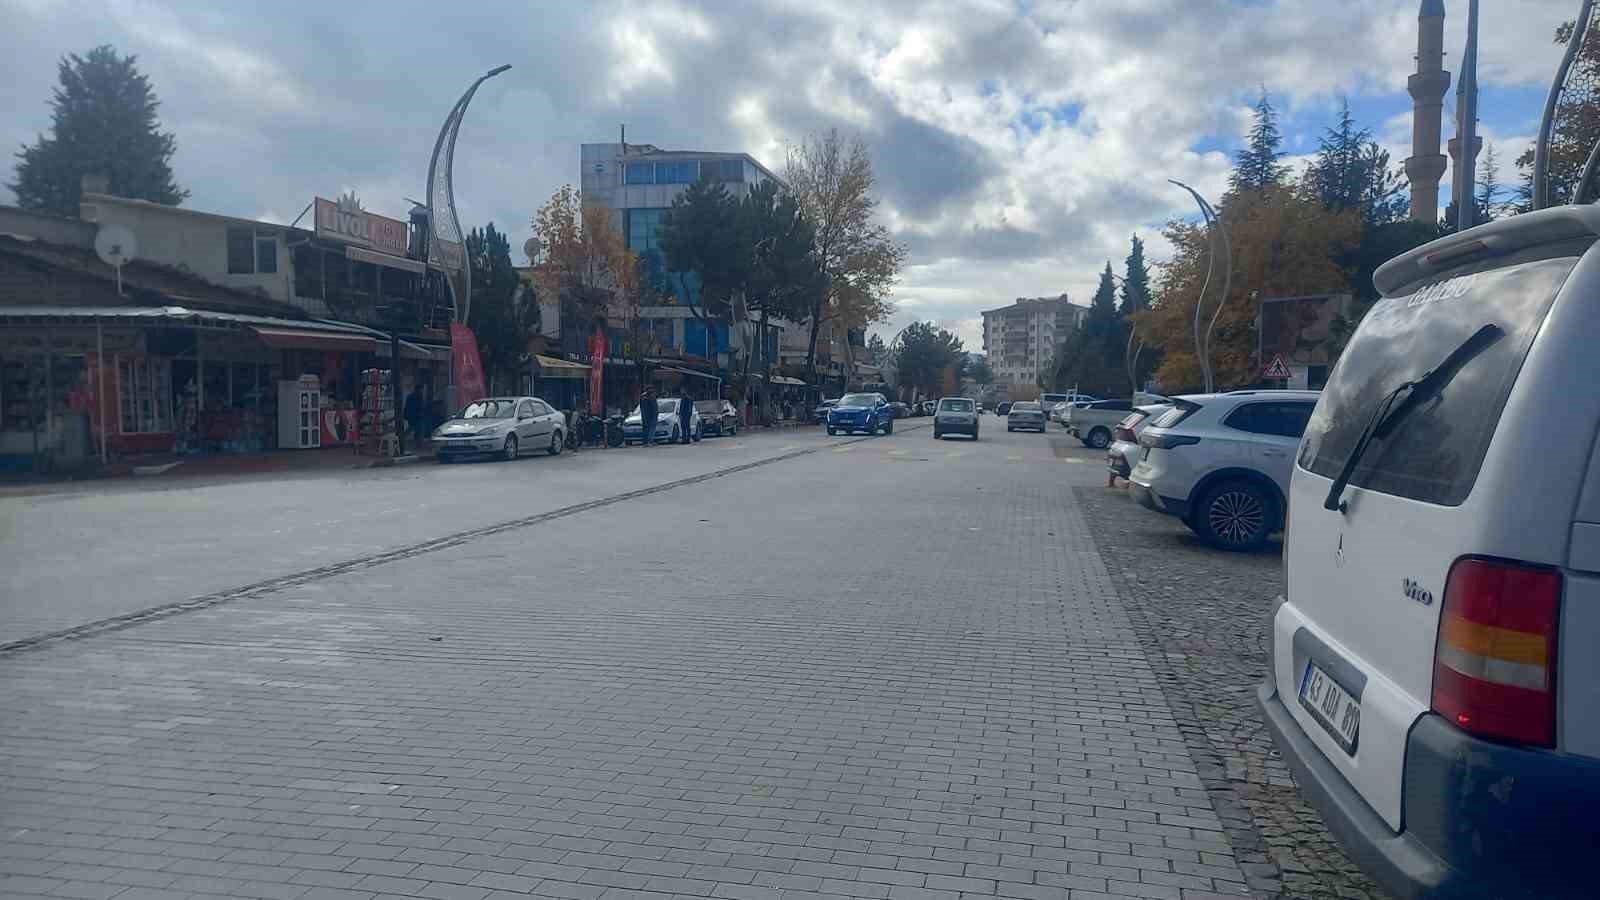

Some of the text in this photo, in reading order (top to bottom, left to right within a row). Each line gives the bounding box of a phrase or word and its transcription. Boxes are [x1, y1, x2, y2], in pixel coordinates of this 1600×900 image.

[1403, 577, 1432, 605] Vito
[1311, 671, 1322, 703] 43
[1321, 683, 1341, 721] ADA
